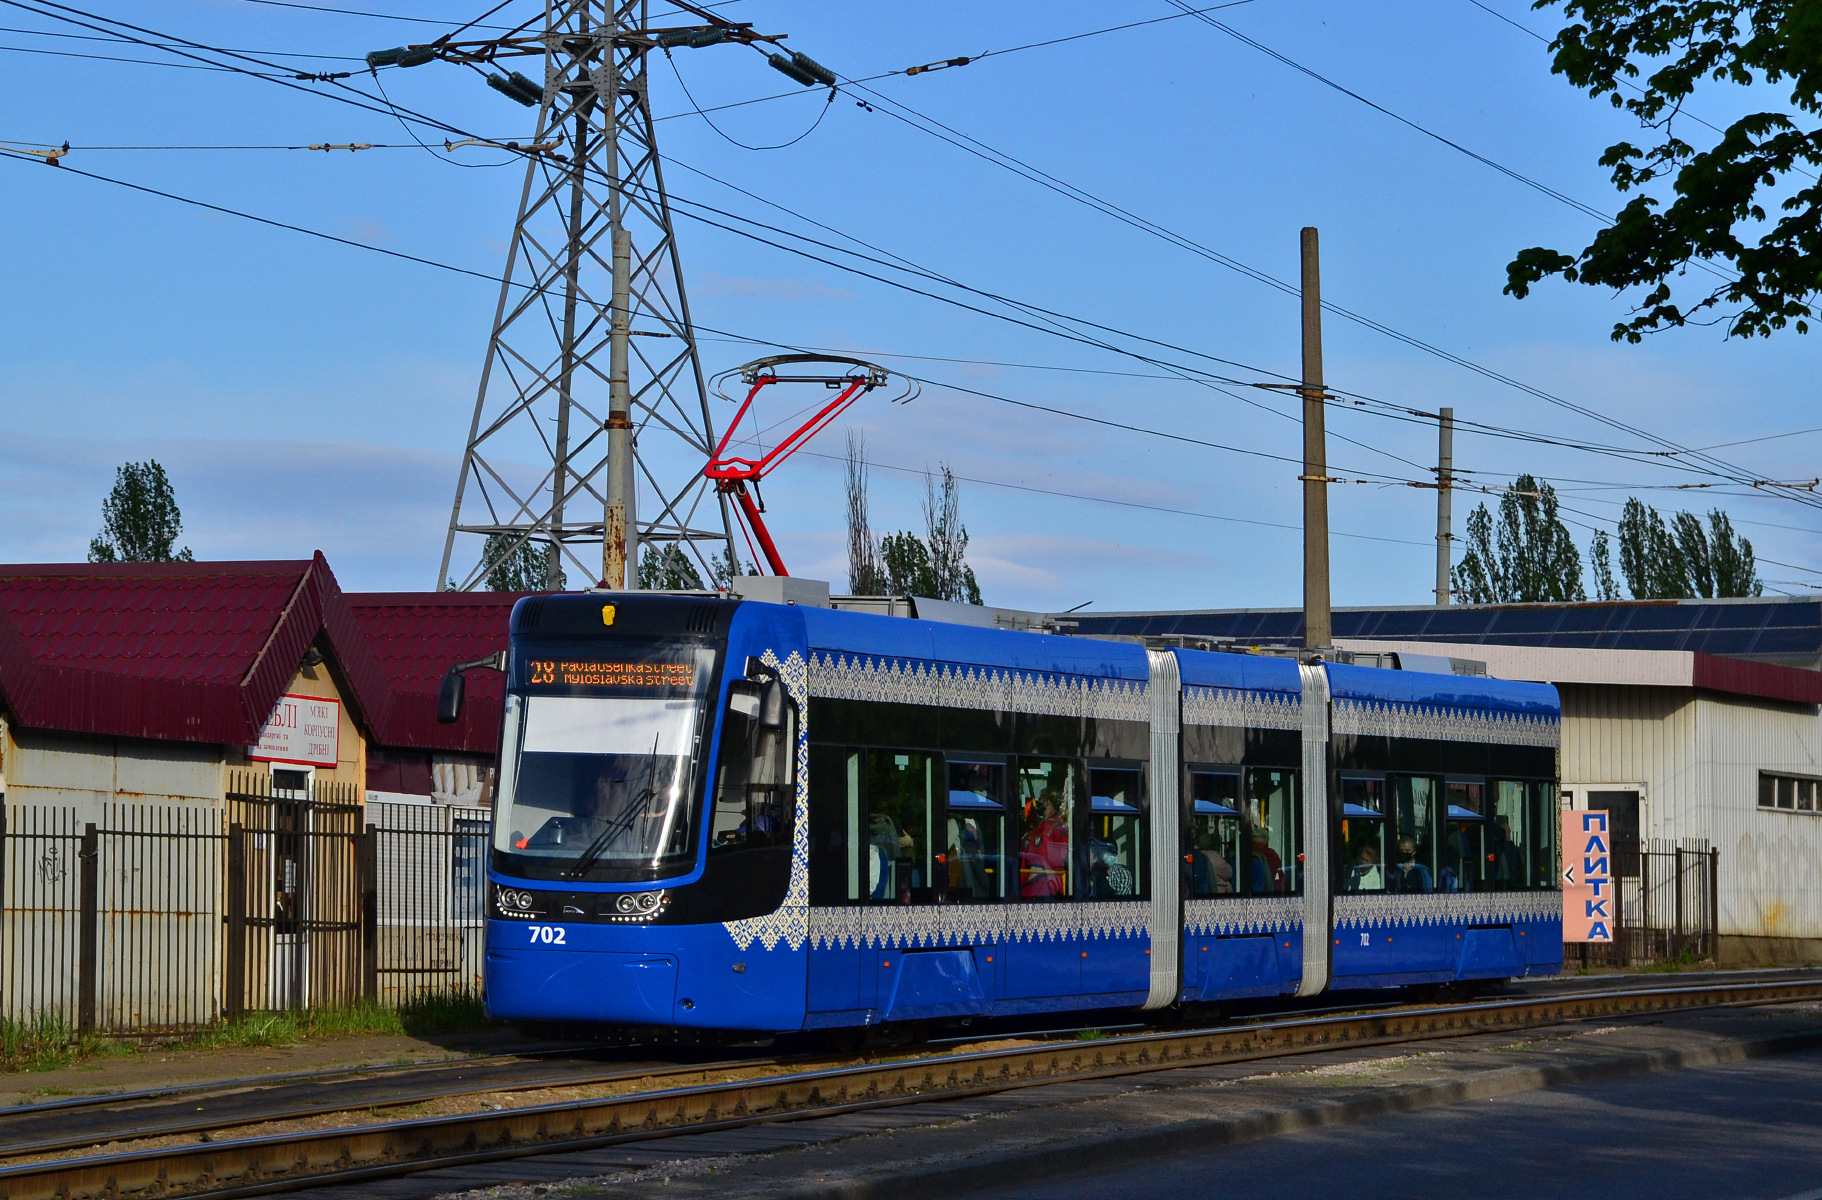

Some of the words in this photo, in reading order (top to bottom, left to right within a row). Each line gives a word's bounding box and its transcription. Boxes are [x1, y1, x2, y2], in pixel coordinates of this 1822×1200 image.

[531, 661, 555, 683] 28
[266, 703, 298, 728] ЕБЛІ
[304, 723, 335, 739] КОРПУСНІ
[308, 743, 330, 756] ДРІБНІ
[1583, 814, 1611, 940] ПЛИТКА
[528, 926, 567, 945] 702
[1360, 932, 1370, 947] 702
